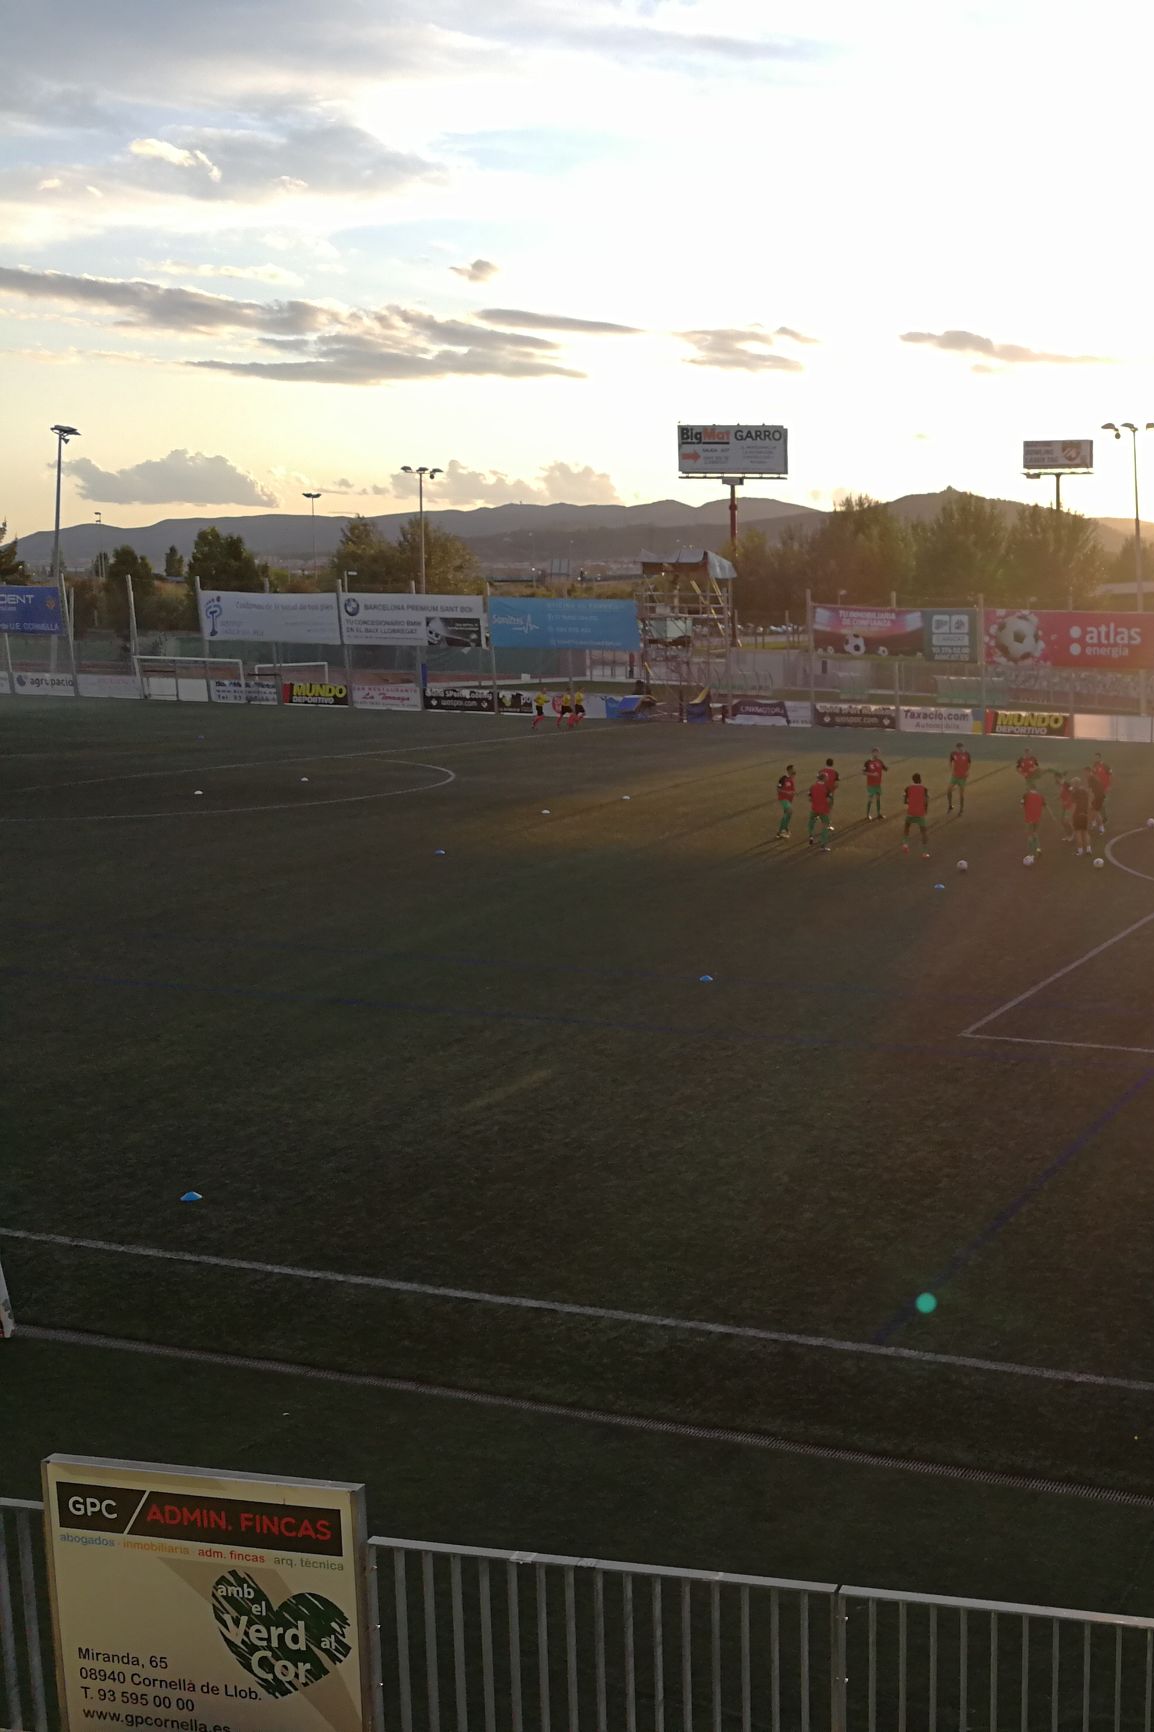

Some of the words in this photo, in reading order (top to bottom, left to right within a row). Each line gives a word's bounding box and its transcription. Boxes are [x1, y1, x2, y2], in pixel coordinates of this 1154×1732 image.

[681, 427, 731, 444] BigMat
[734, 430, 782, 441] GARRO
[1085, 621, 1142, 646] atlas
[292, 682, 347, 698] MUNDO
[292, 696, 335, 704] DEPORTIVO
[996, 725, 1047, 736] DEPORTIVO
[997, 711, 1064, 728] MUNDO
[68, 1495, 118, 1519] GPC
[146, 1503, 232, 1533] ADMIN.
[239, 1511, 333, 1542] FINCAS
[59, 1532, 115, 1549] abogados
[122, 1537, 190, 1556] inmobiliaria
[198, 1548, 228, 1561] adm.
[229, 1549, 266, 1565] fincas
[274, 1557, 297, 1567] arq.
[217, 1583, 255, 1599] amb
[251, 1600, 267, 1616] el
[222, 1613, 307, 1651] Verd
[320, 1634, 337, 1650] al
[78, 1646, 145, 1670] Miranda,
[149, 1654, 169, 1670] 65
[250, 1650, 312, 1684] Cor
[79, 1666, 126, 1684] 08940
[200, 1682, 220, 1696] de
[224, 1684, 262, 1701] Llob.
[80, 1685, 94, 1700] T.
[97, 1688, 116, 1703] 93
[121, 1690, 149, 1707] 595
[153, 1695, 172, 1710] 00
[176, 1697, 195, 1713] 00
[82, 1707, 231, 1732] www.gpcornella.es
